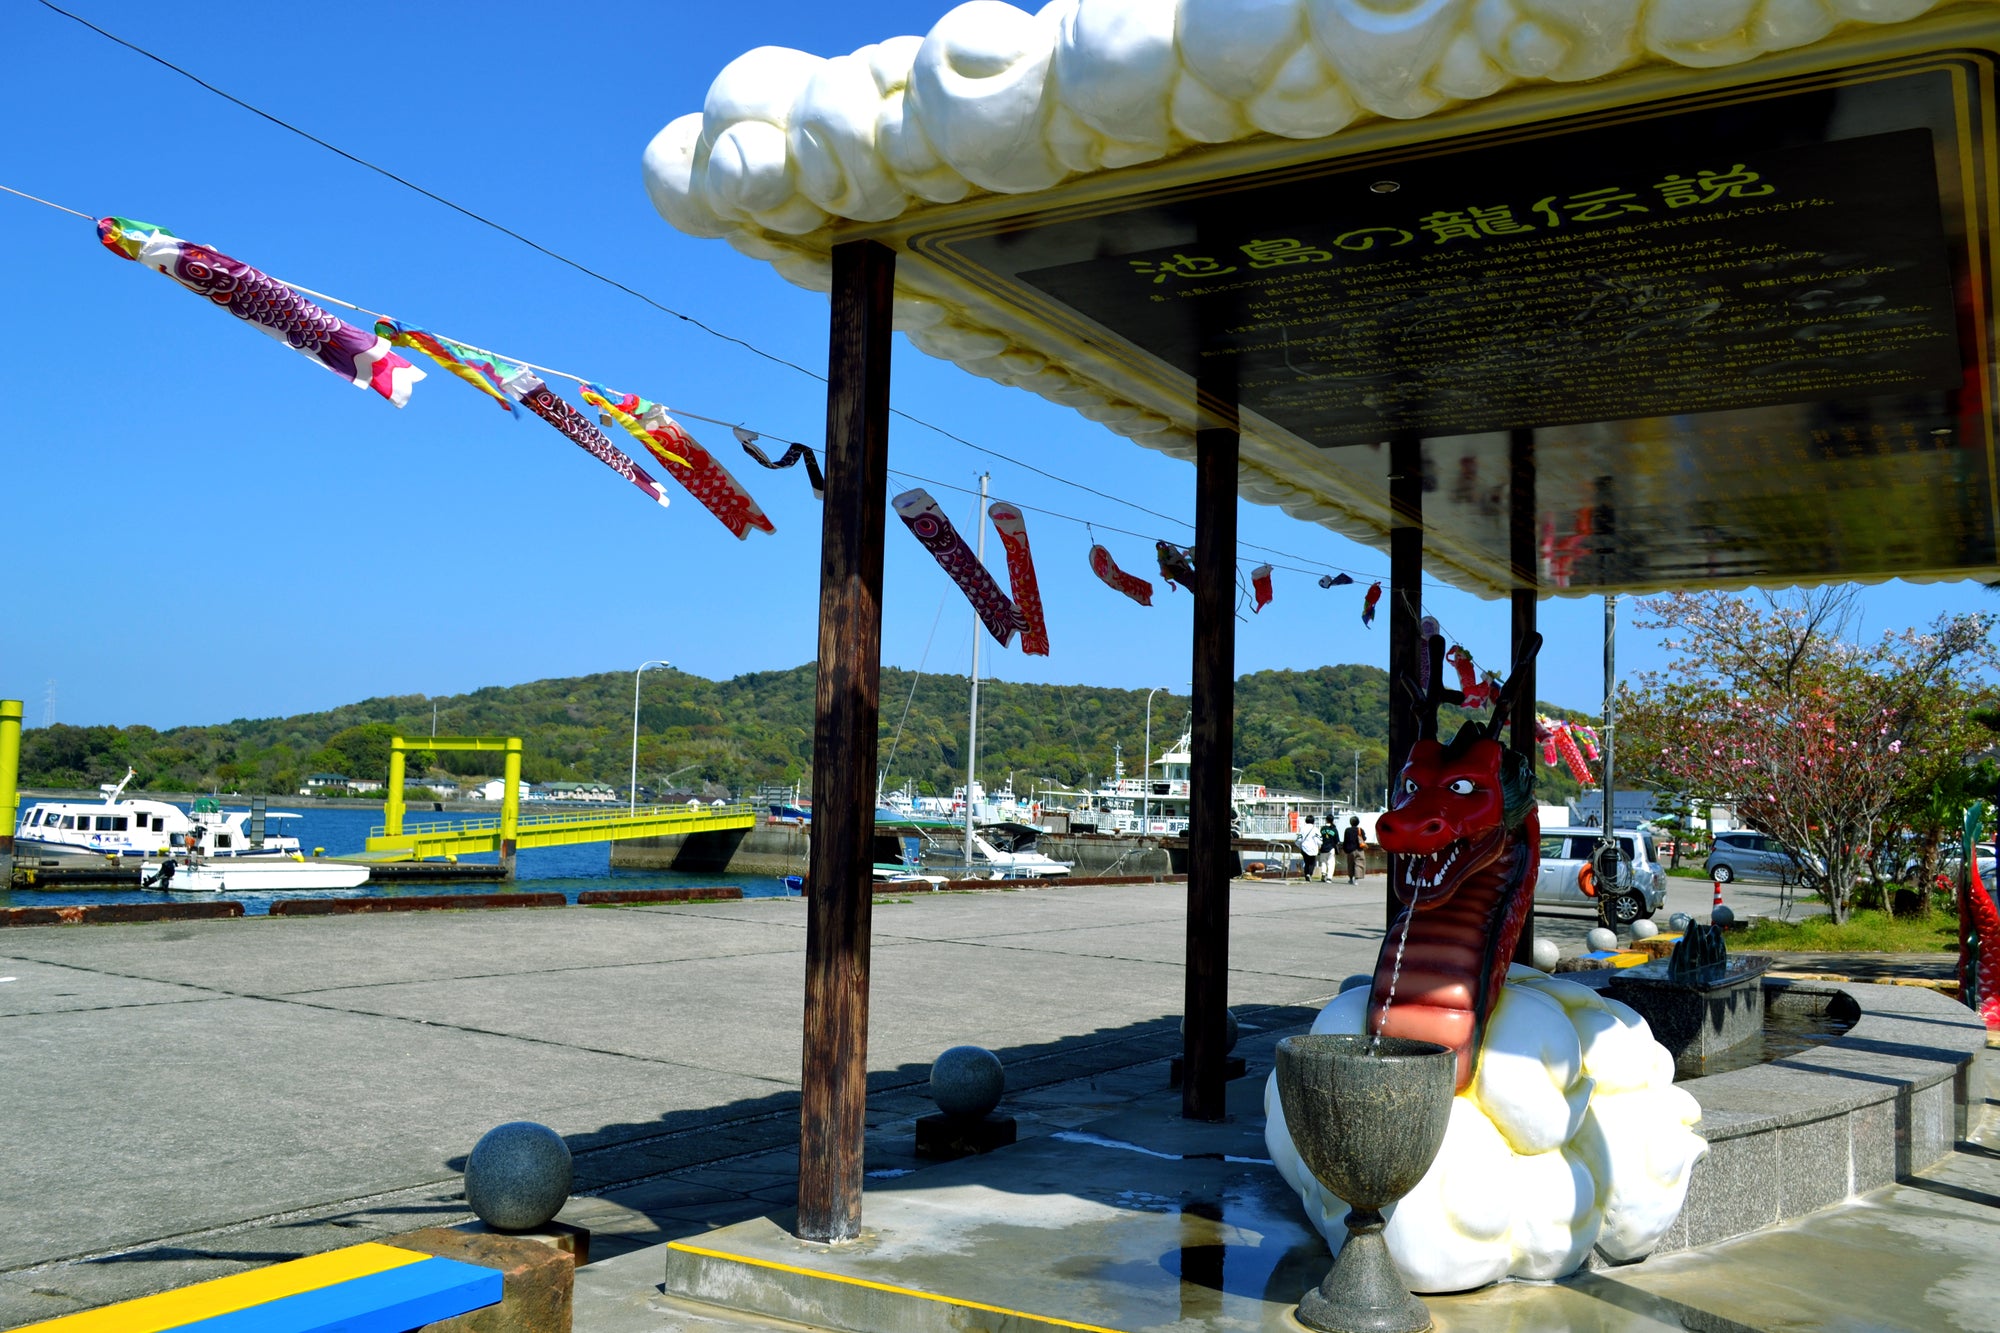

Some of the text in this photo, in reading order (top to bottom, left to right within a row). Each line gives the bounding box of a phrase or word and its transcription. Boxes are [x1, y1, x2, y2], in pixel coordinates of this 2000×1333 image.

[1128, 163, 1775, 283] 池島の龍伝説
[1119, 820, 1139, 831] 三原
